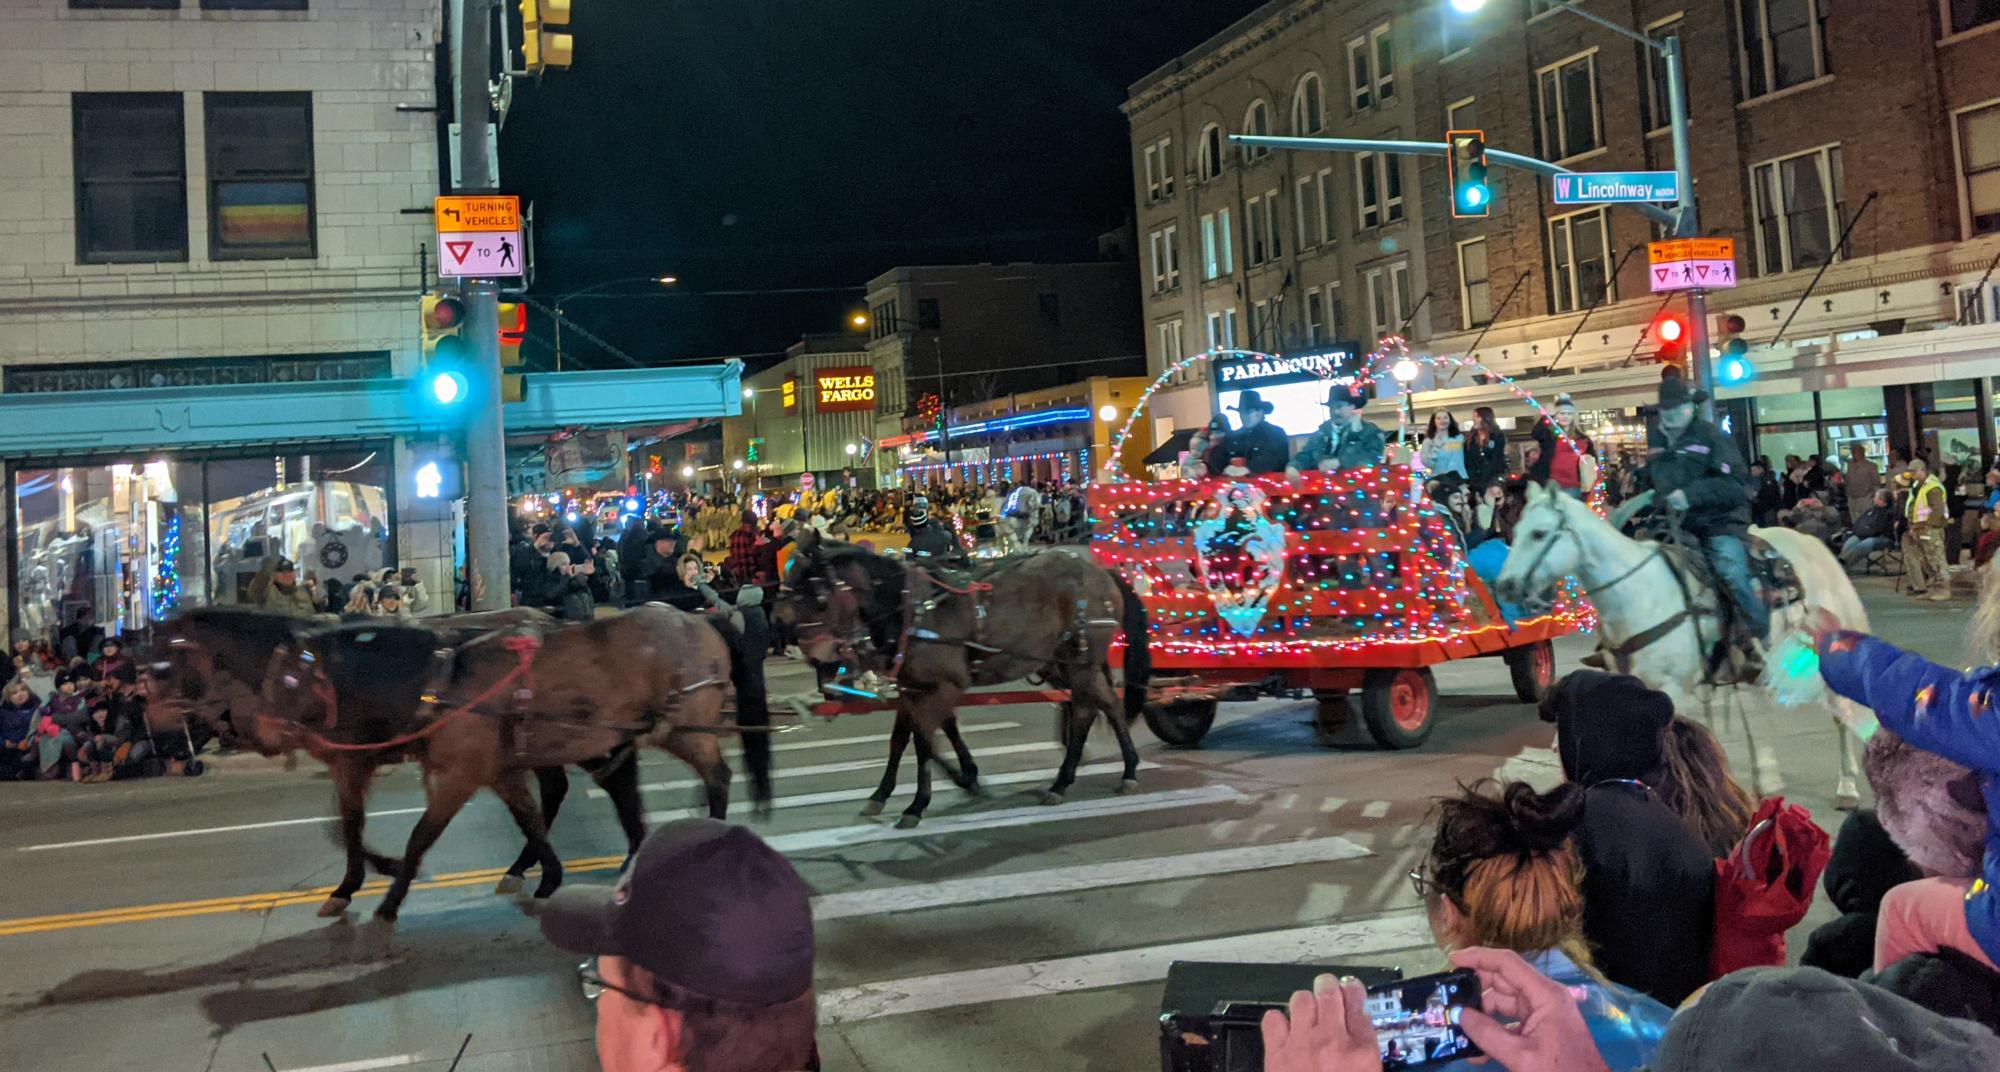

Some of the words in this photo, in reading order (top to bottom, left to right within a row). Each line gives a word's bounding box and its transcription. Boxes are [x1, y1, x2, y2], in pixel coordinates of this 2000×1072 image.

[1557, 178, 1571, 199] W
[1578, 177, 1653, 200] Lincolnway
[465, 202, 512, 212] TURNING
[465, 216, 514, 226] VEHICLES
[477, 248, 491, 257] TO
[1221, 351, 1346, 382] PARAMOUNT
[818, 375, 875, 389] WELLS
[820, 388, 875, 403] FARGO
